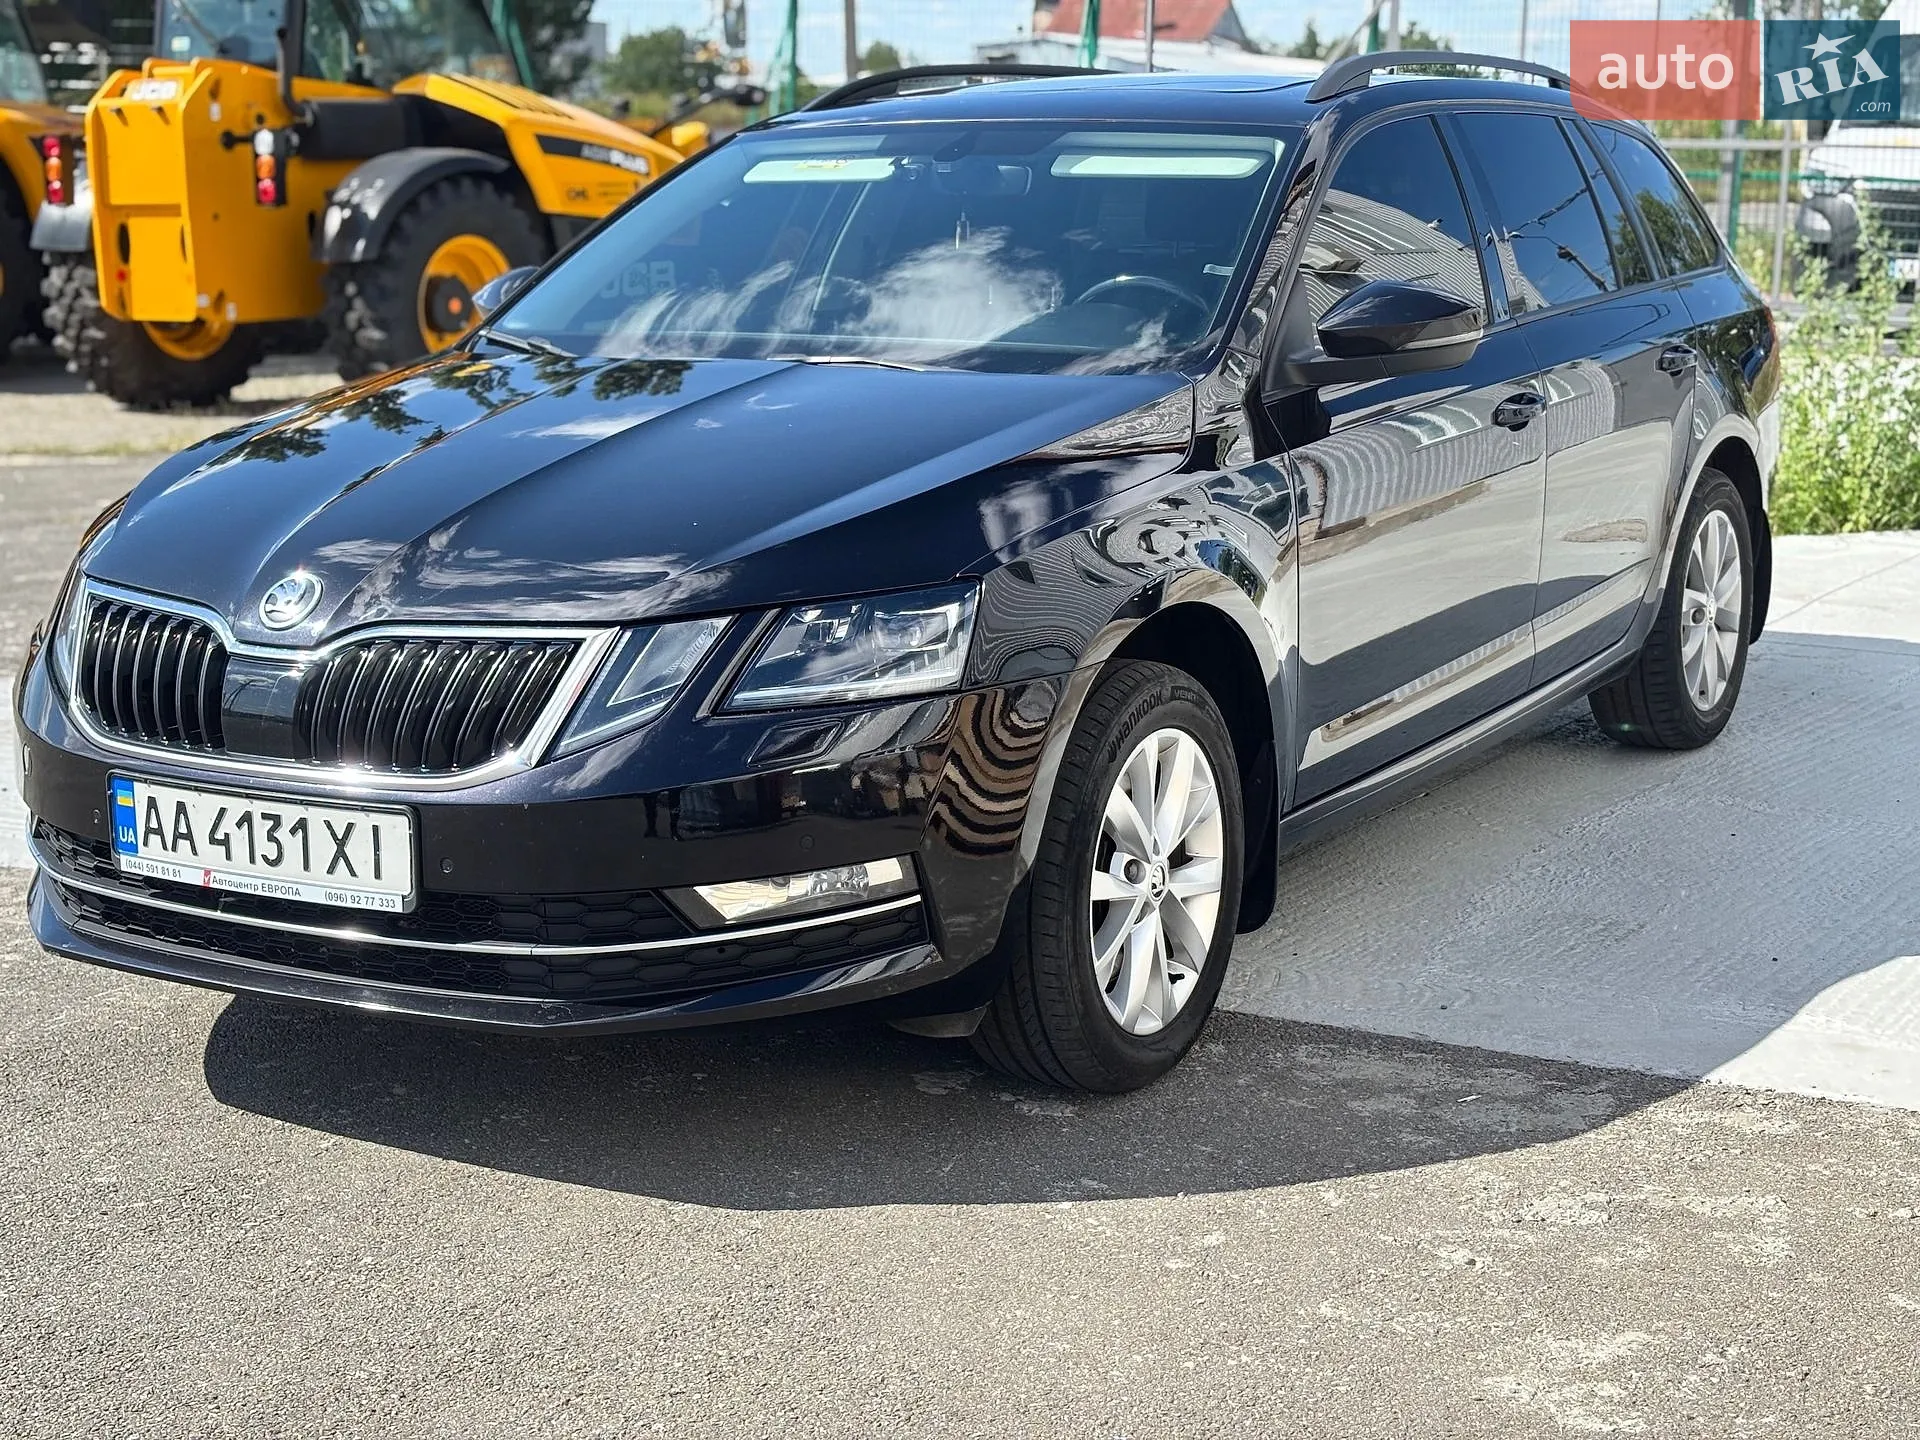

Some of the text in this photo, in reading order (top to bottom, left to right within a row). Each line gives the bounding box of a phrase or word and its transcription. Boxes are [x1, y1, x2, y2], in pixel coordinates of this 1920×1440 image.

[118, 824, 136, 845] UA
[142, 795, 383, 881] AA 4131 XI
[125, 858, 182, 879] (044) 591 81 81
[212, 875, 302, 898] Автоцентр ЕВРОПА
[324, 889, 397, 910] (096) 92 77 333
